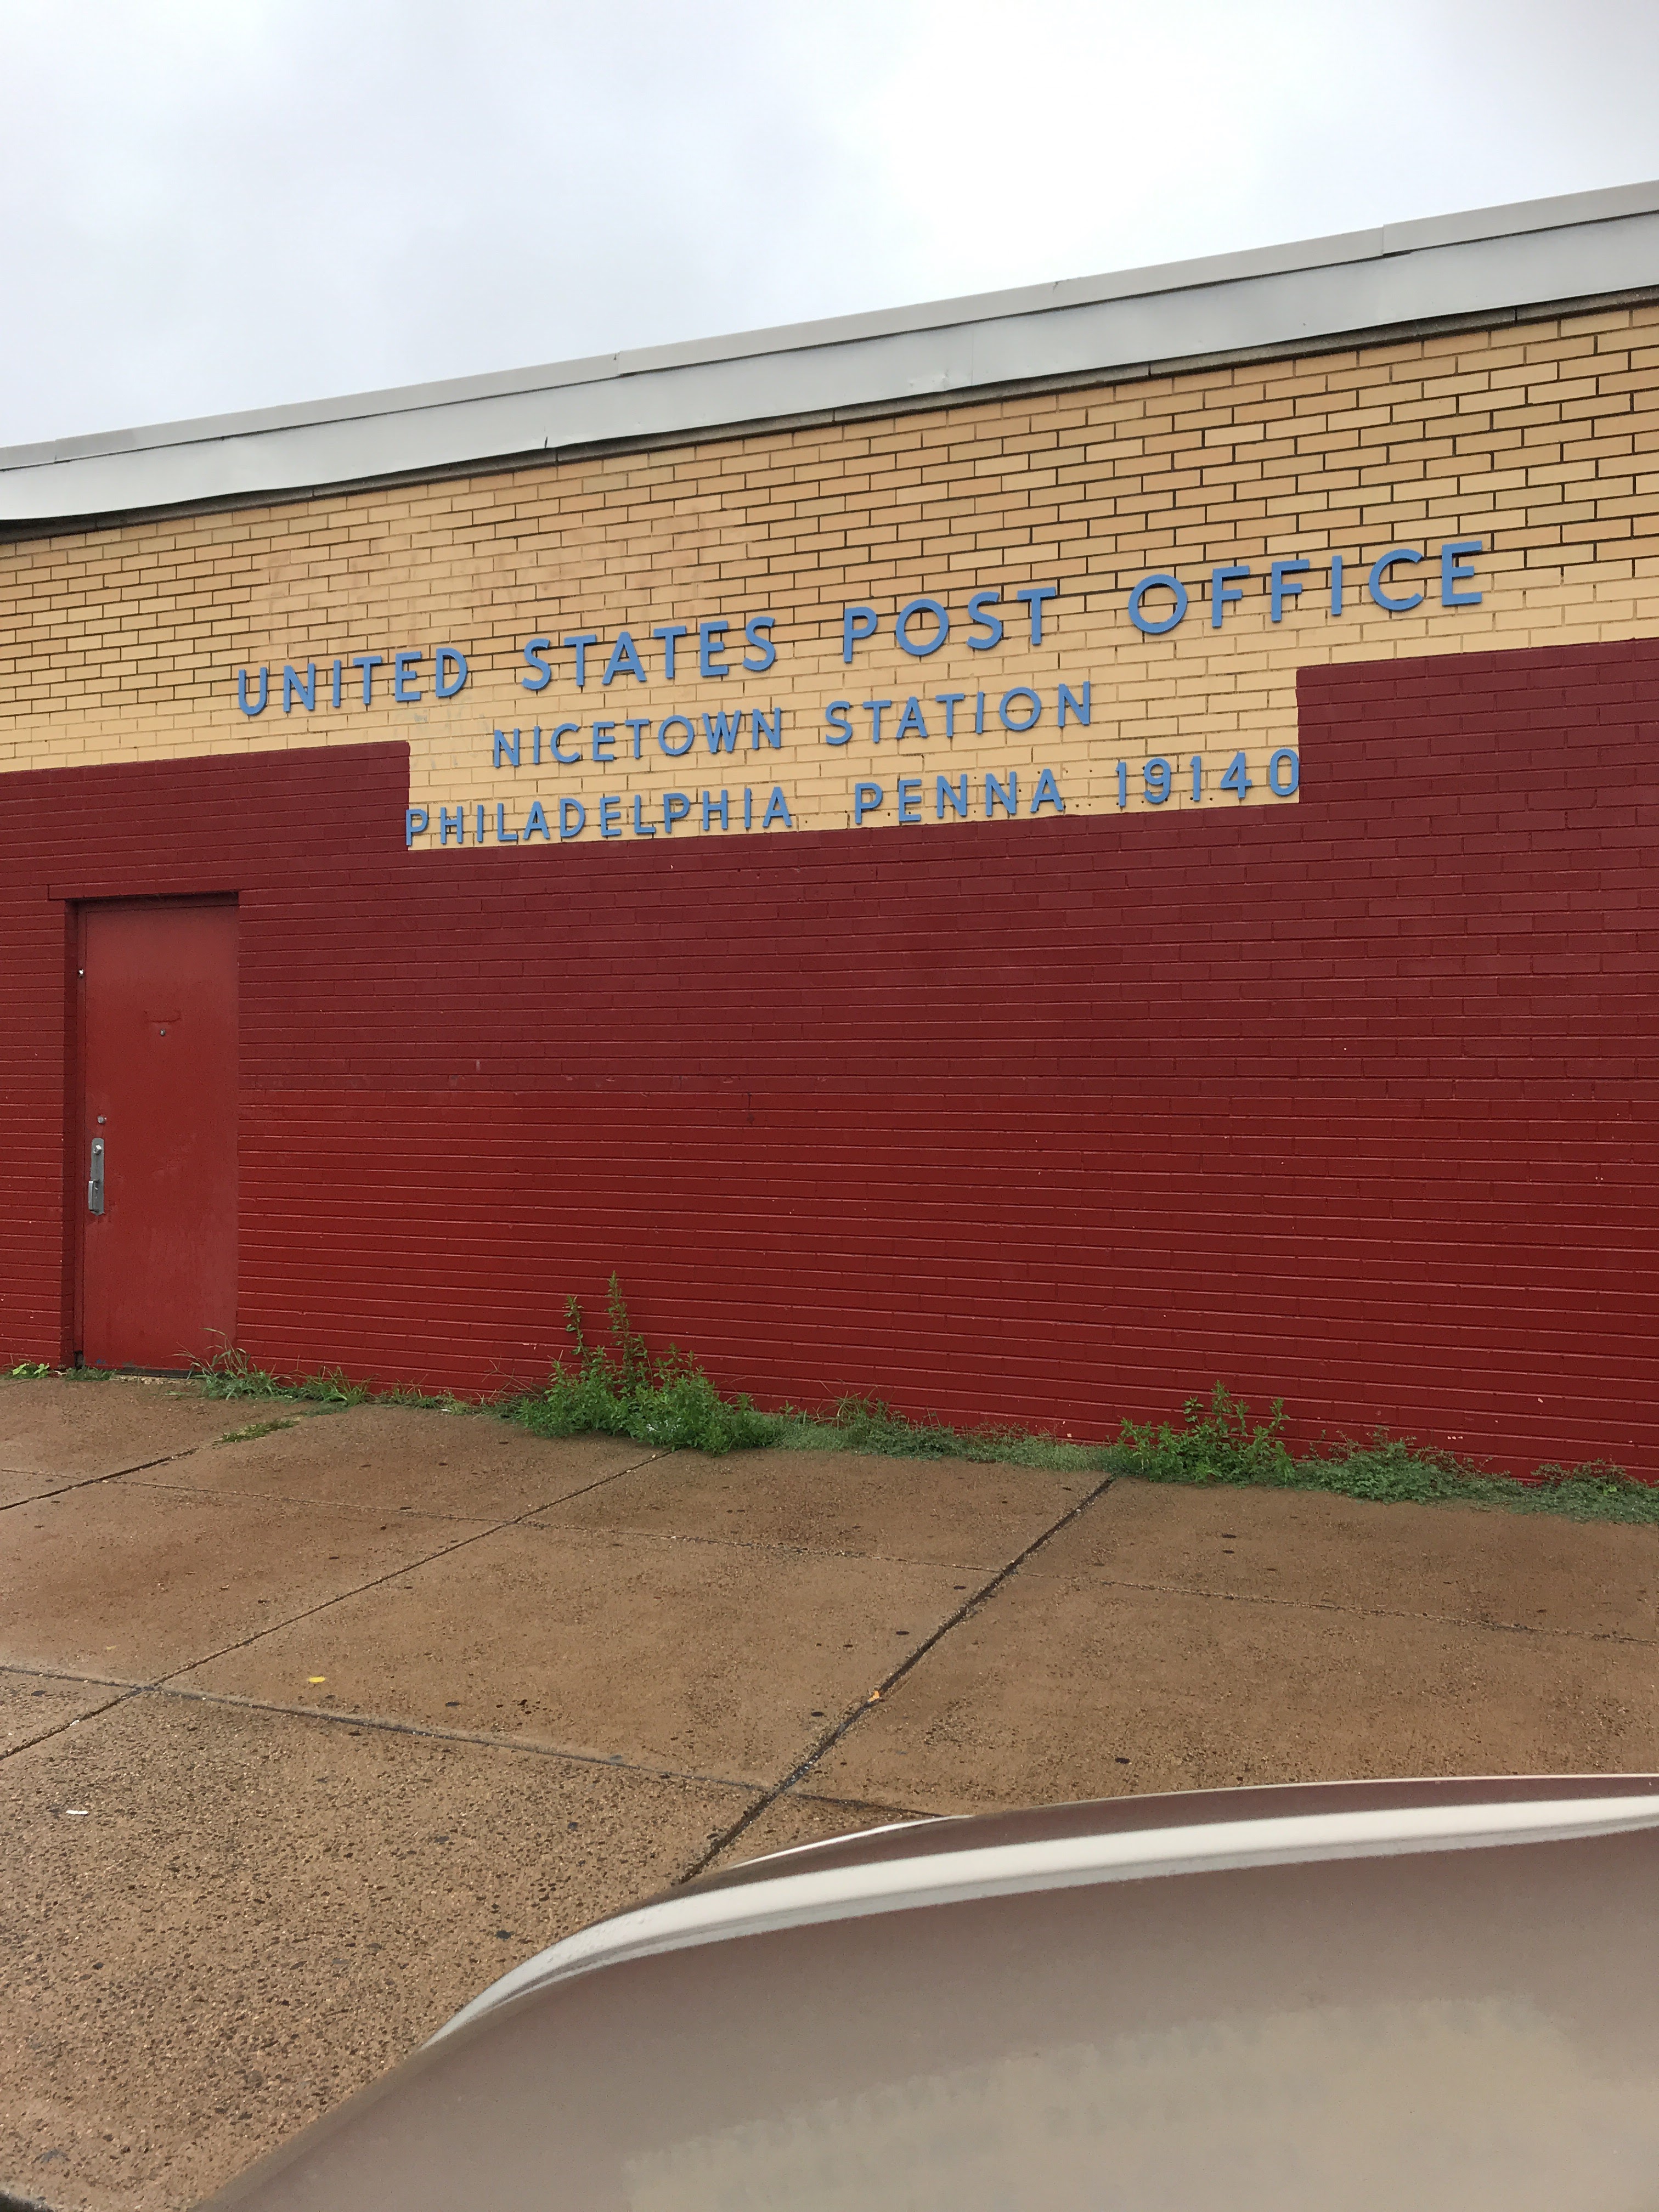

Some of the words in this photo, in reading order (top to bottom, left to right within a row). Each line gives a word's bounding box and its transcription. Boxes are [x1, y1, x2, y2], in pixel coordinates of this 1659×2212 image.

[238, 647, 469, 715] UNITED
[521, 616, 776, 691] STATES
[843, 587, 1057, 663] POST
[1128, 540, 1483, 634] OFFICE
[494, 707, 782, 767] NICETOWN
[825, 682, 1092, 745] STATION
[405, 787, 792, 845] PHILADELPHIA
[854, 769, 1063, 824] PENNA
[1116, 748, 1300, 807] 19140
